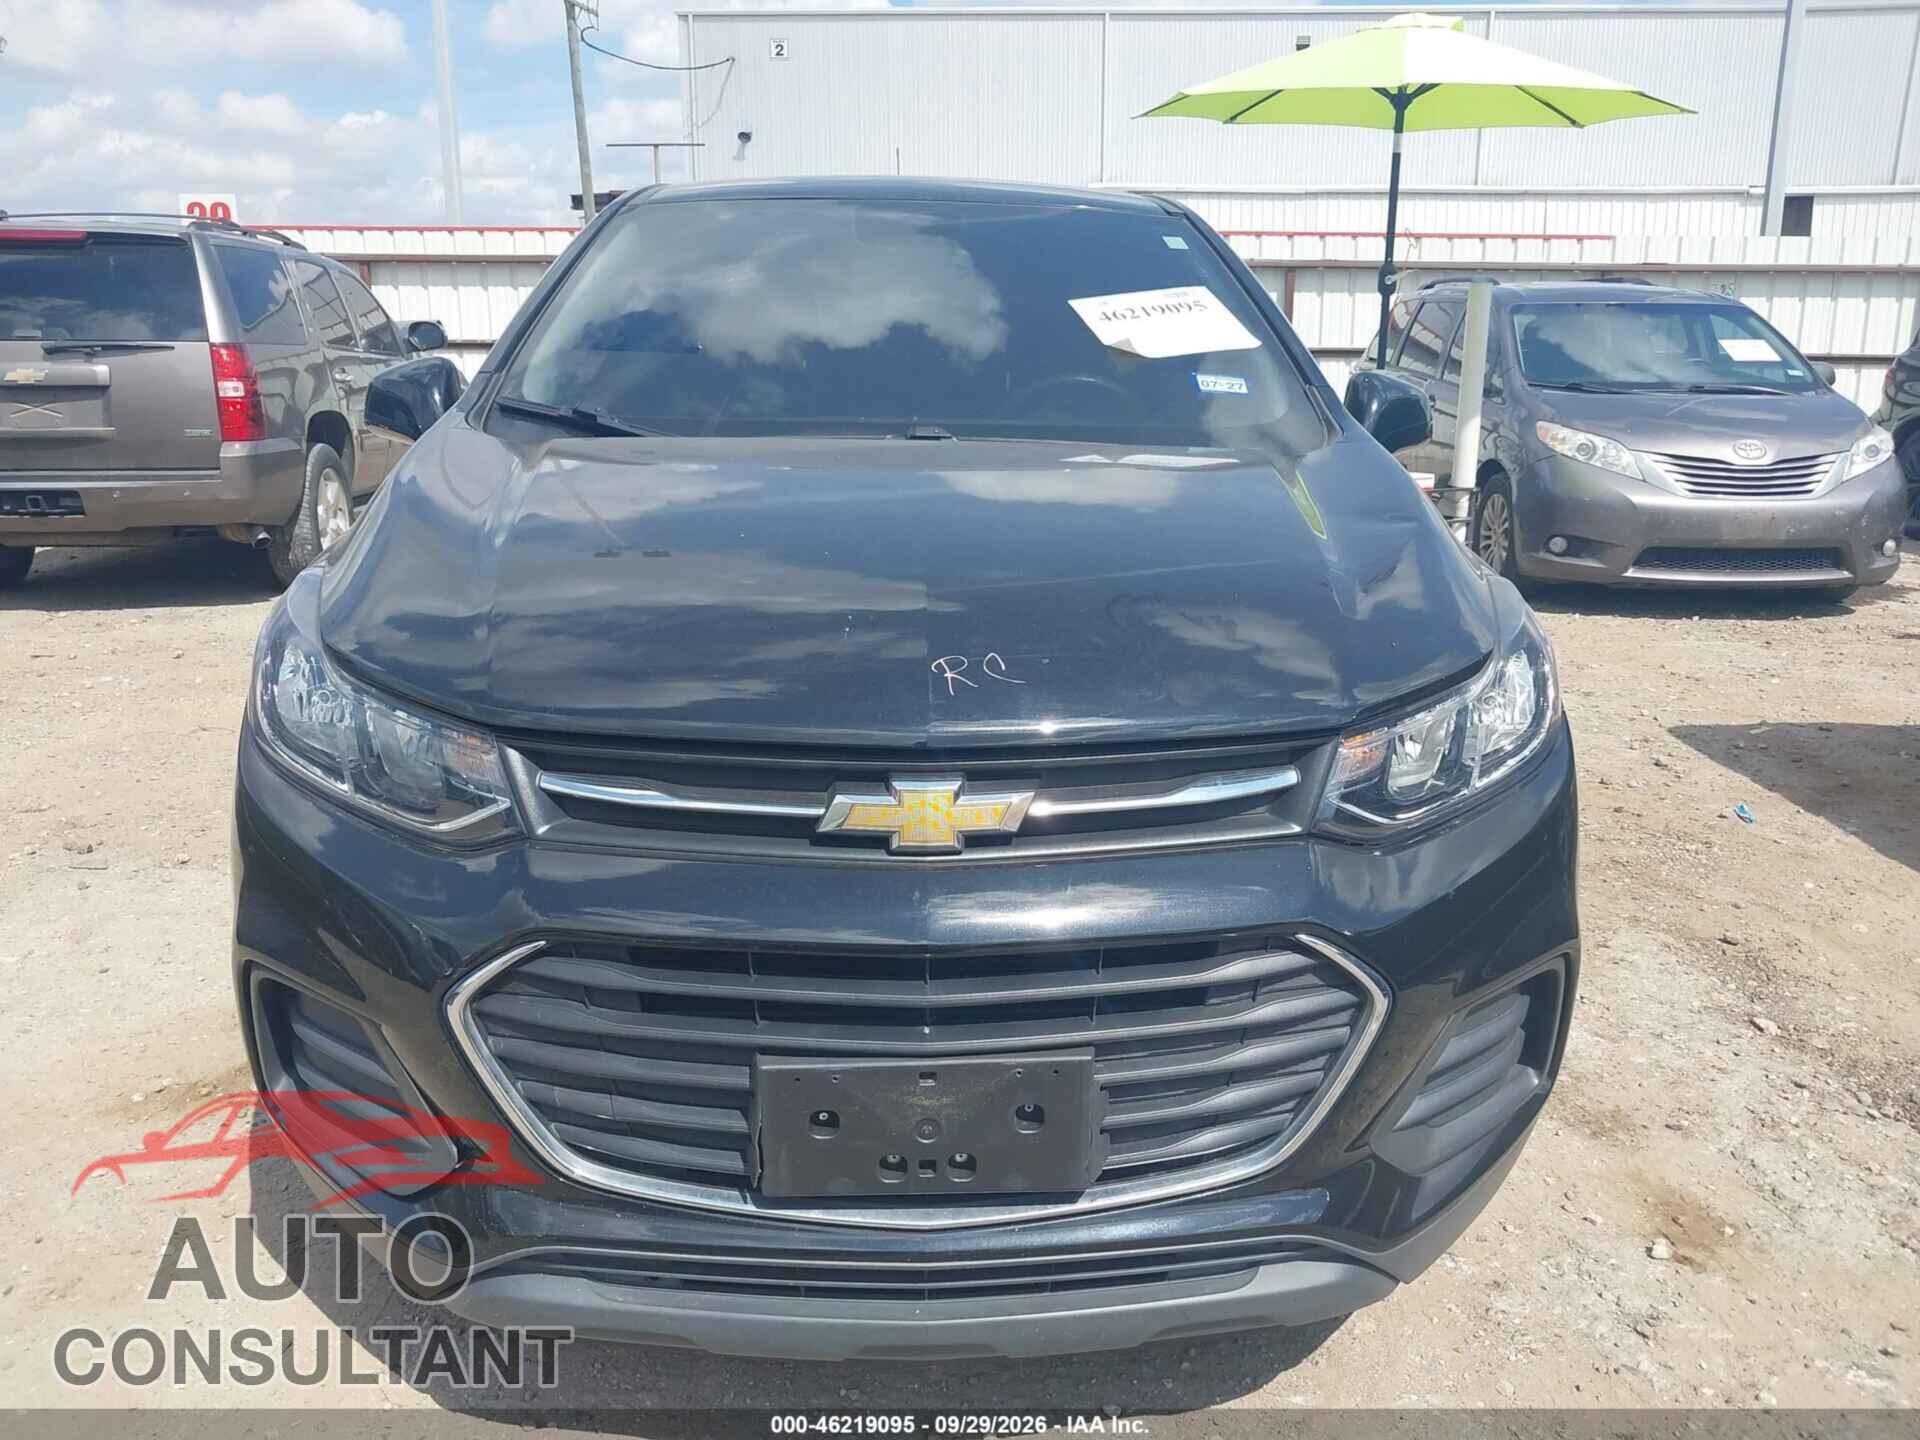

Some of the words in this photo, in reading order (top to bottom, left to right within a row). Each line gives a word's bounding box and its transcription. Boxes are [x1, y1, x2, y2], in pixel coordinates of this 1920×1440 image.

[775, 44, 784, 56] 2
[1099, 300, 1209, 322] 46219095
[1200, 379, 1244, 391] 07-27
